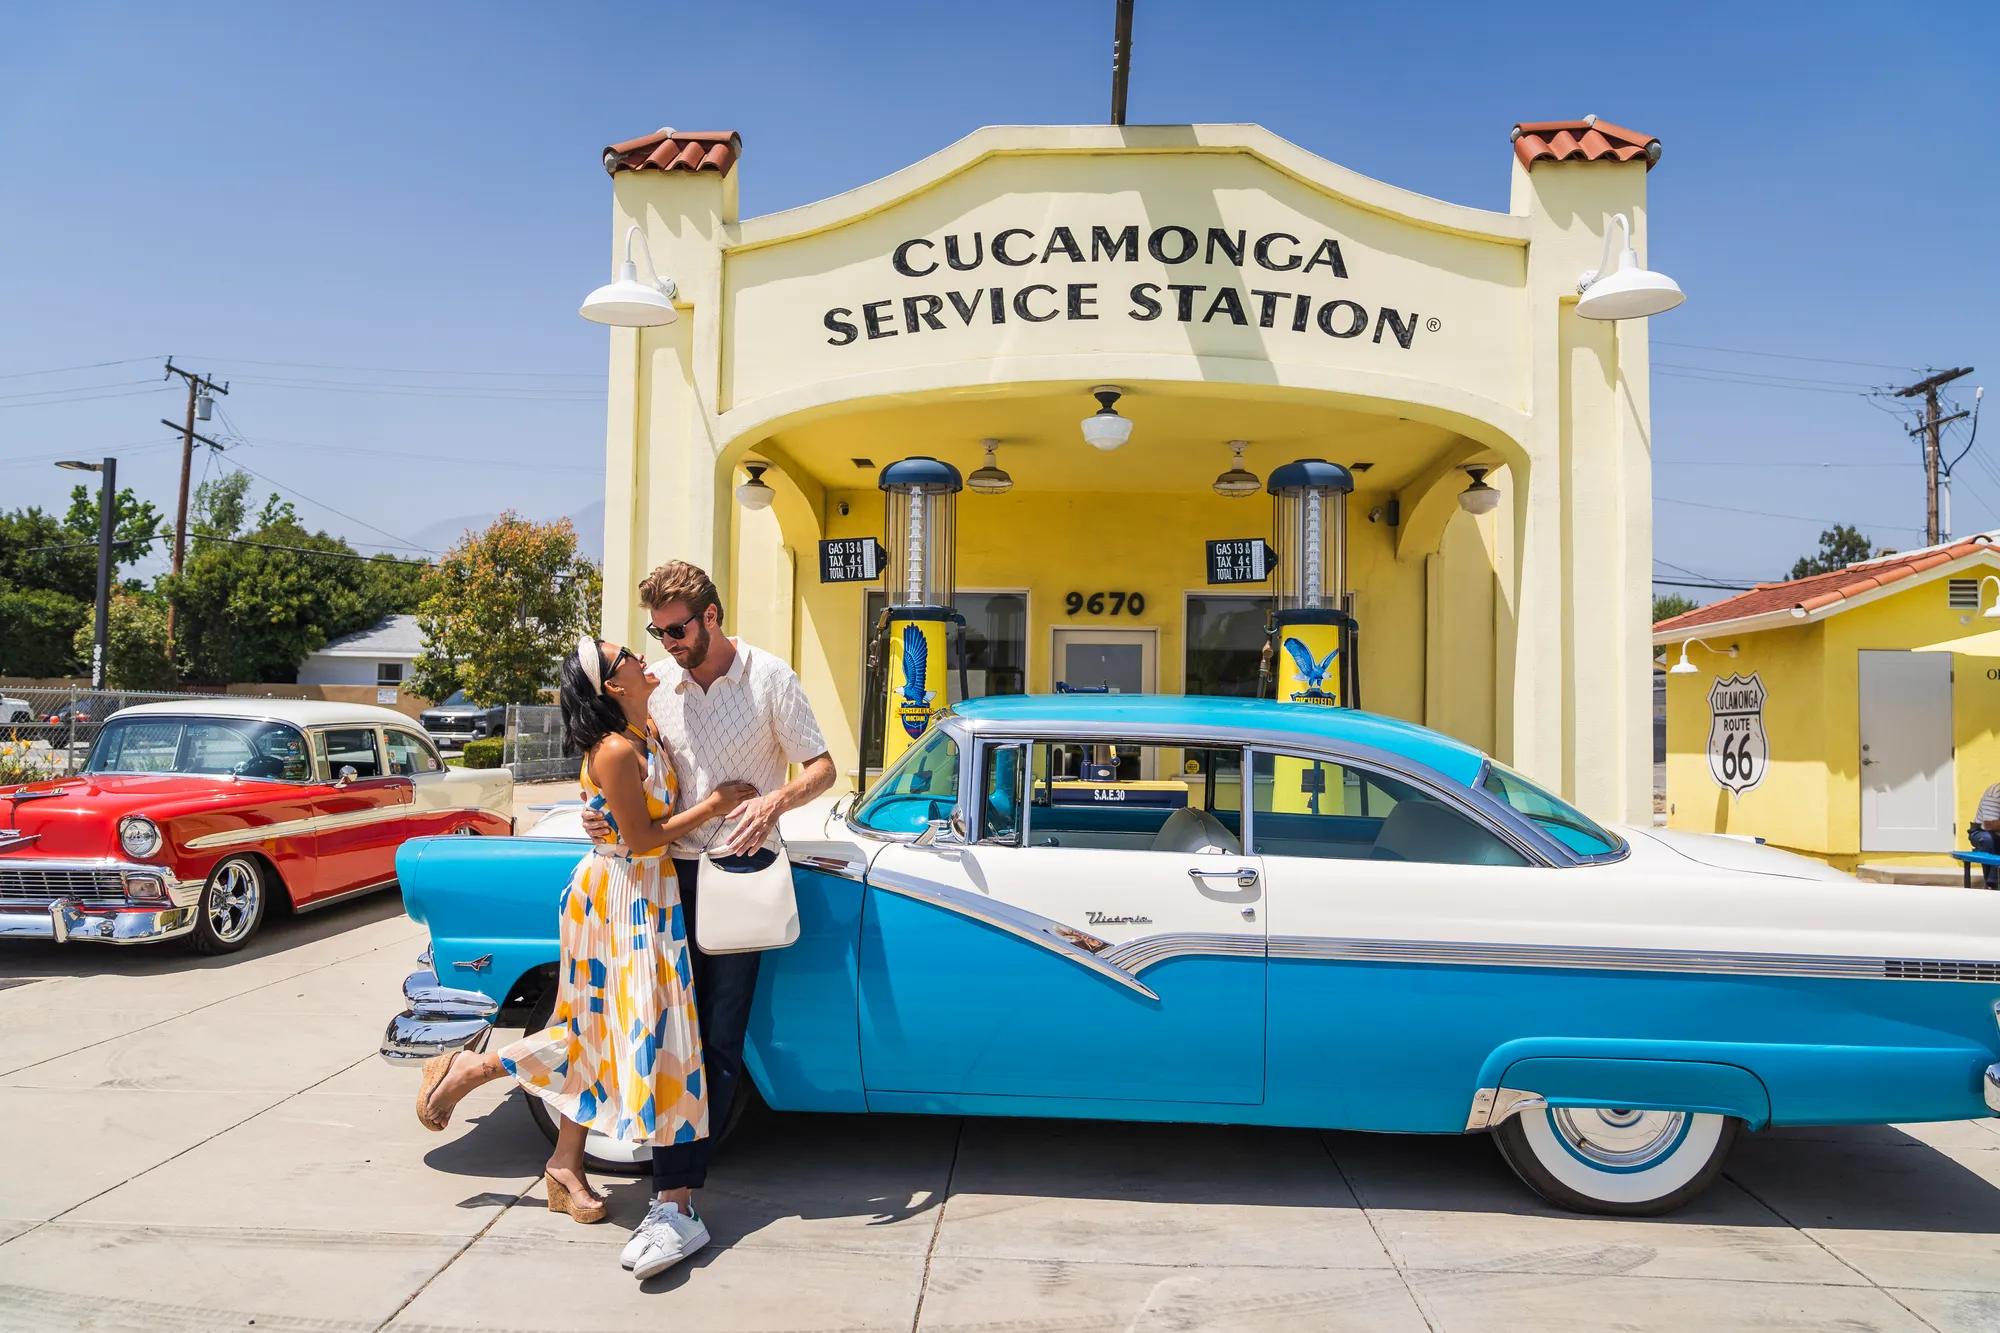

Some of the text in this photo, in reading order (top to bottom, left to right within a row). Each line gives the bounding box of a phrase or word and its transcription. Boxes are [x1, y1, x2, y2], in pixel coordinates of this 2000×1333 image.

[893, 225, 1349, 279] CUCAMONGA
[824, 283, 1098, 346] SERVICE
[828, 542, 843, 554] GAS
[1216, 543, 1231, 555] GAS
[829, 555, 844, 567] TAX
[1217, 556, 1232, 567] TAX
[829, 567, 844, 579] TOTAL
[1217, 568, 1232, 580] TOTAL
[1066, 592, 1145, 616] 9670
[1715, 690, 1758, 710] CUCAMONGA
[1724, 719, 1750, 731] ROUTE
[1723, 732, 1752, 781] 66
[1085, 912, 1152, 924] Victoria
